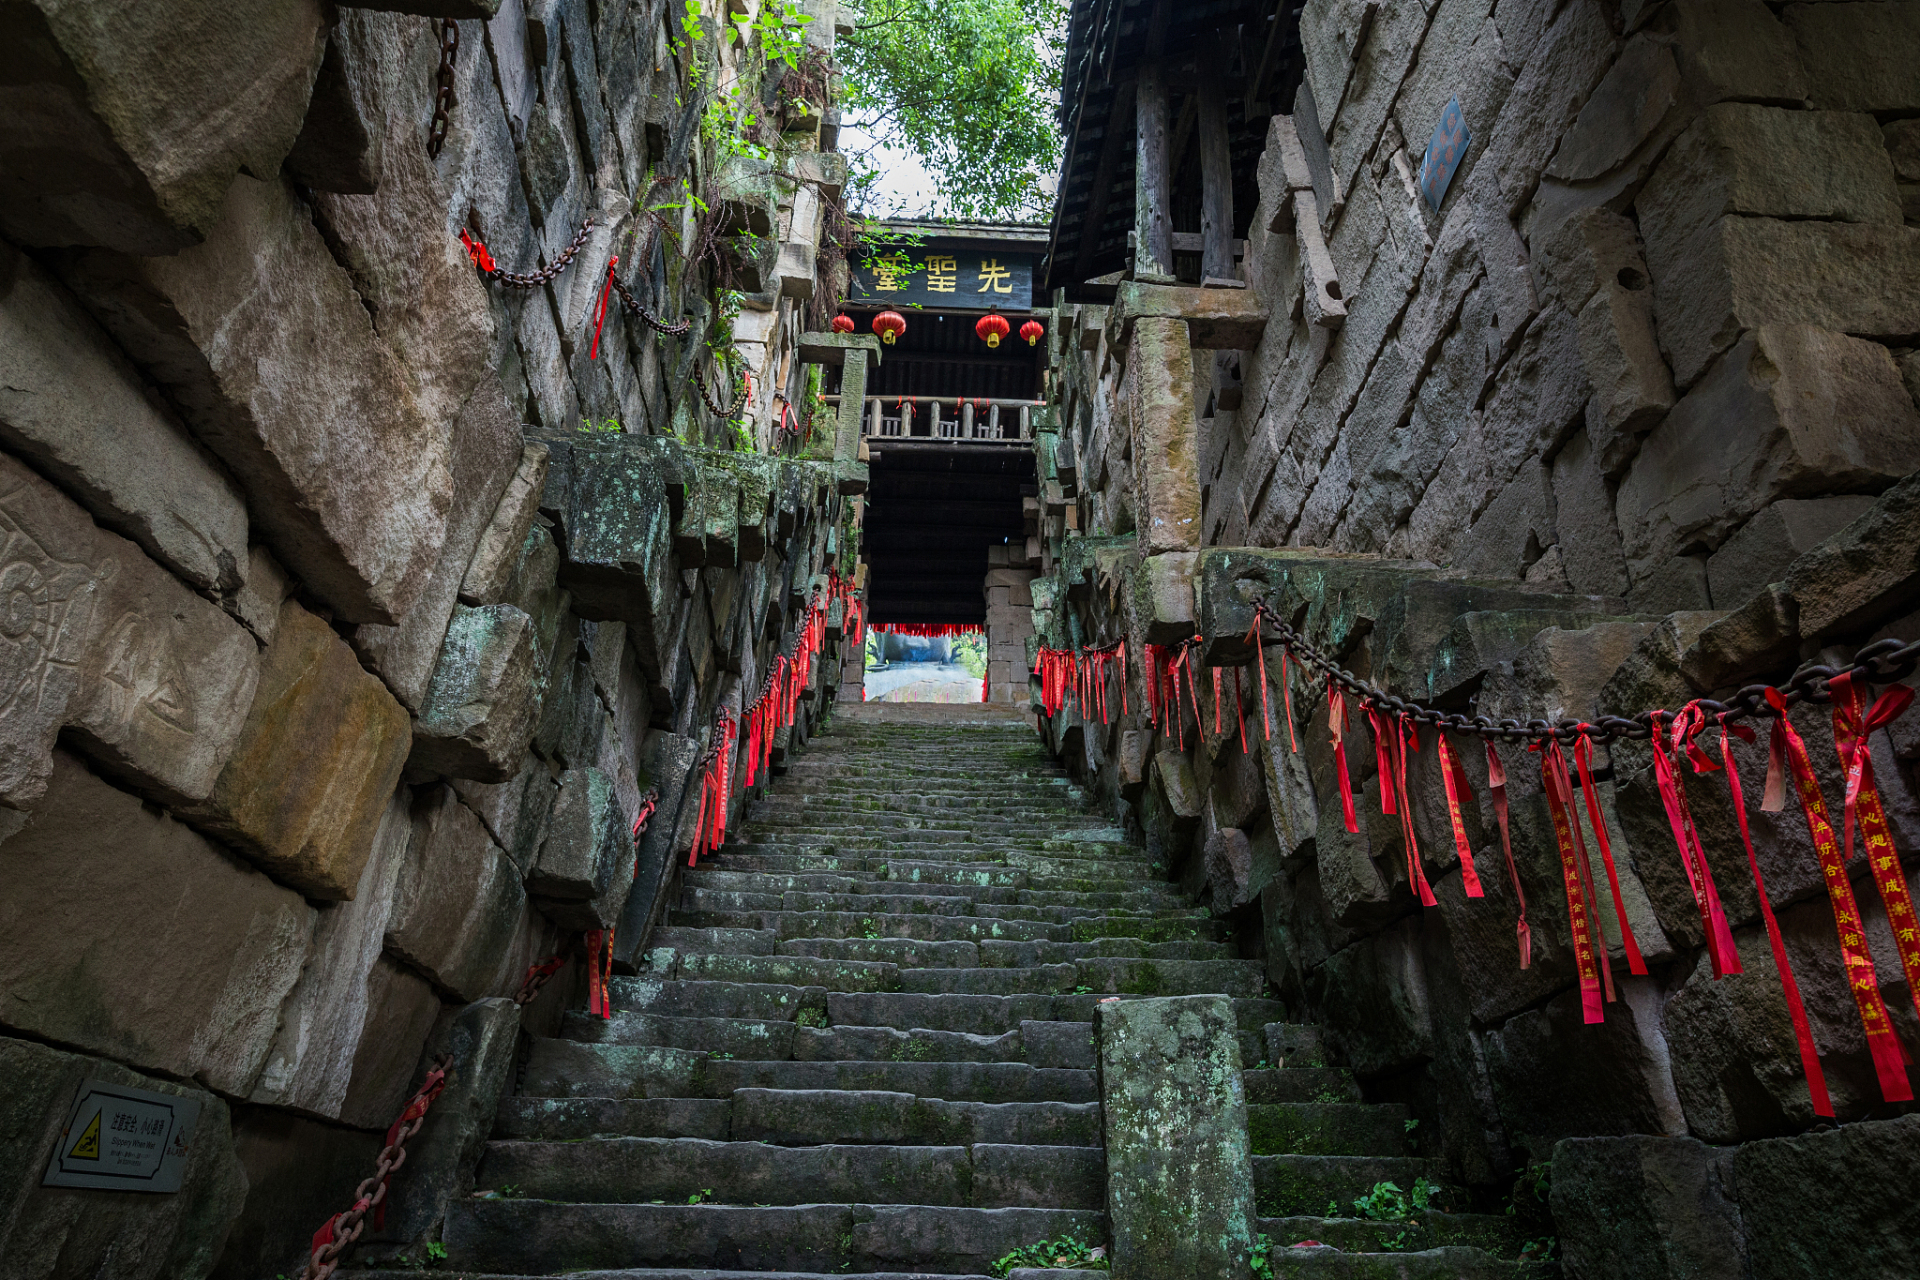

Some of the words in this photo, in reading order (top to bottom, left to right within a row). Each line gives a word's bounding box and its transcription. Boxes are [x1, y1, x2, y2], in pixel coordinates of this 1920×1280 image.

[1559, 826, 1578, 881] 学业有成
[1573, 902, 1591, 961] 金榜题名
[1810, 801, 1838, 878] 百年好合
[1839, 910, 1871, 992] 永结同心
[1863, 811, 1901, 894] 心想事成
[1898, 927, 1920, 992] 有求
[111, 1136, 133, 1148] Slippery
[132, 1139, 146, 1148] When
[145, 1141, 156, 1150] Wet
